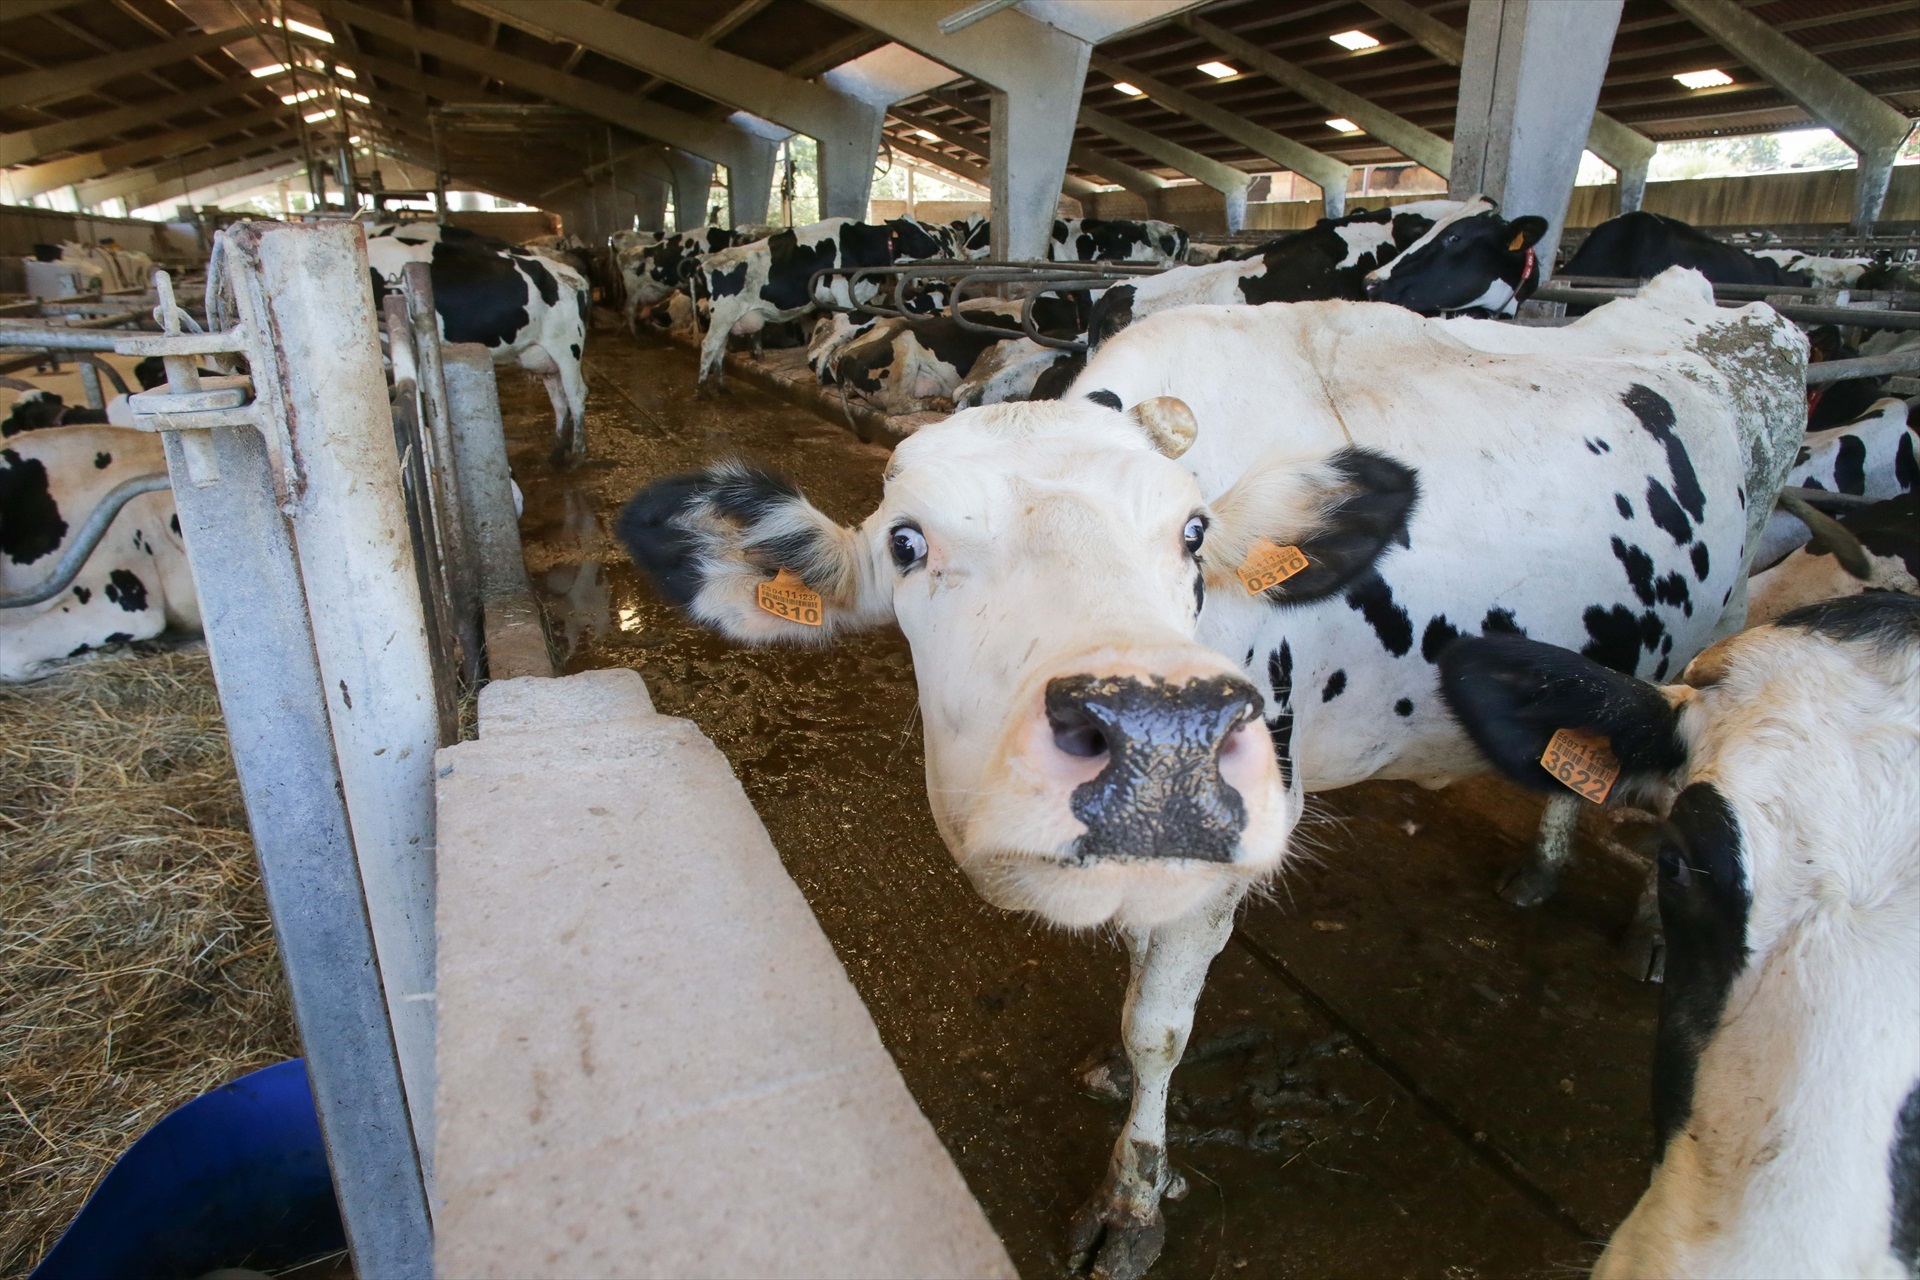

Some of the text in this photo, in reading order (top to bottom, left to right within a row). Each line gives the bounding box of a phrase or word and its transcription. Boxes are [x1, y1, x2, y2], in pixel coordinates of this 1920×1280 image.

[1247, 557, 1304, 592] 0310
[761, 596, 819, 624] 0310
[1544, 750, 1607, 802] 3622
